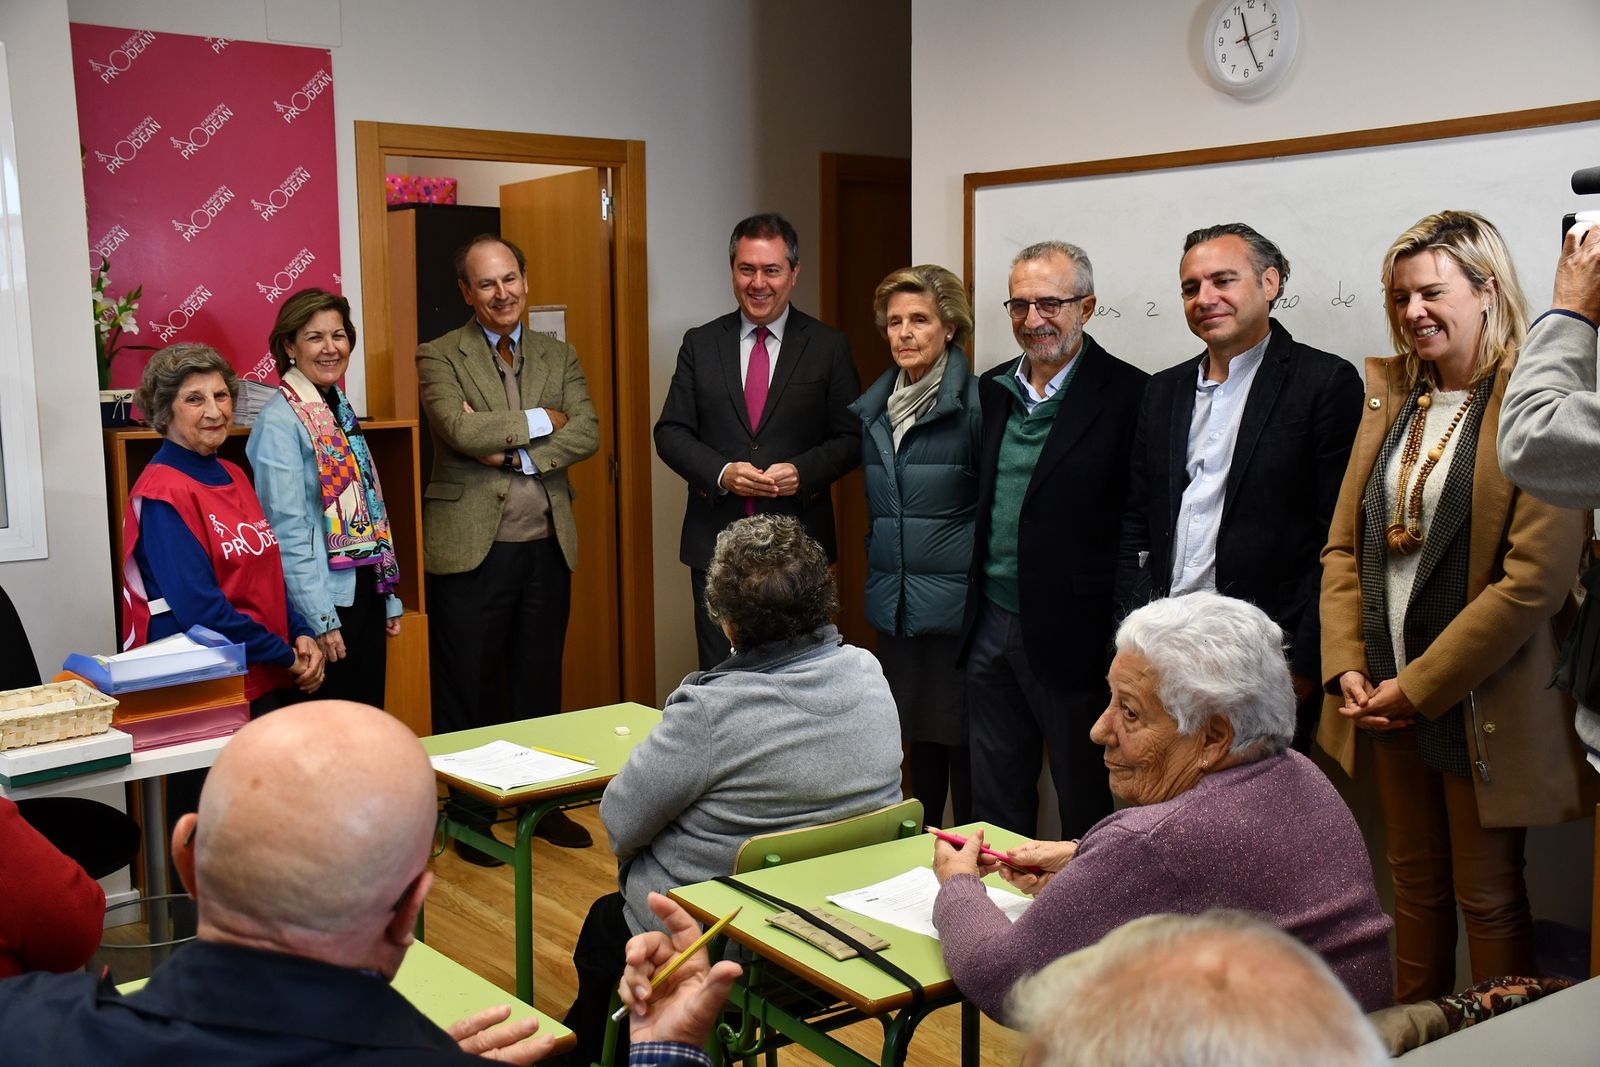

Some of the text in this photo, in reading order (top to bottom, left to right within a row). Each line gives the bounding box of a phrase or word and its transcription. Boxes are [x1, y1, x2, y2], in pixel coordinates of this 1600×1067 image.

[1246, 0, 1255, 8] 12
[1262, 3, 1267, 12] 1
[1233, 6, 1241, 16] 11
[1271, 13, 1277, 23] 2
[1222, 19, 1231, 29] 10
[1273, 30, 1279, 40] 3
[1218, 37, 1224, 46] 9
[1268, 49, 1274, 57] 4
[1220, 54, 1226, 63] 8
[1231, 65, 1237, 74] 7
[1257, 62, 1264, 72] 5
[1243, 68, 1249, 78] 6
[283, 73, 332, 124] PRODEAN
[180, 107, 234, 160] PRODEAN
[106, 120, 162, 174] PRODEAN
[261, 169, 311, 221] PRODEAN
[182, 188, 235, 242] PRODEAN
[266, 251, 315, 303] PRODEAN
[1094, 305, 1121, 318] es
[1146, 301, 1160, 317] 2
[1331, 280, 1356, 308] de
[160, 288, 212, 343] PRODEAN
[221, 522, 278, 560] PRODE
